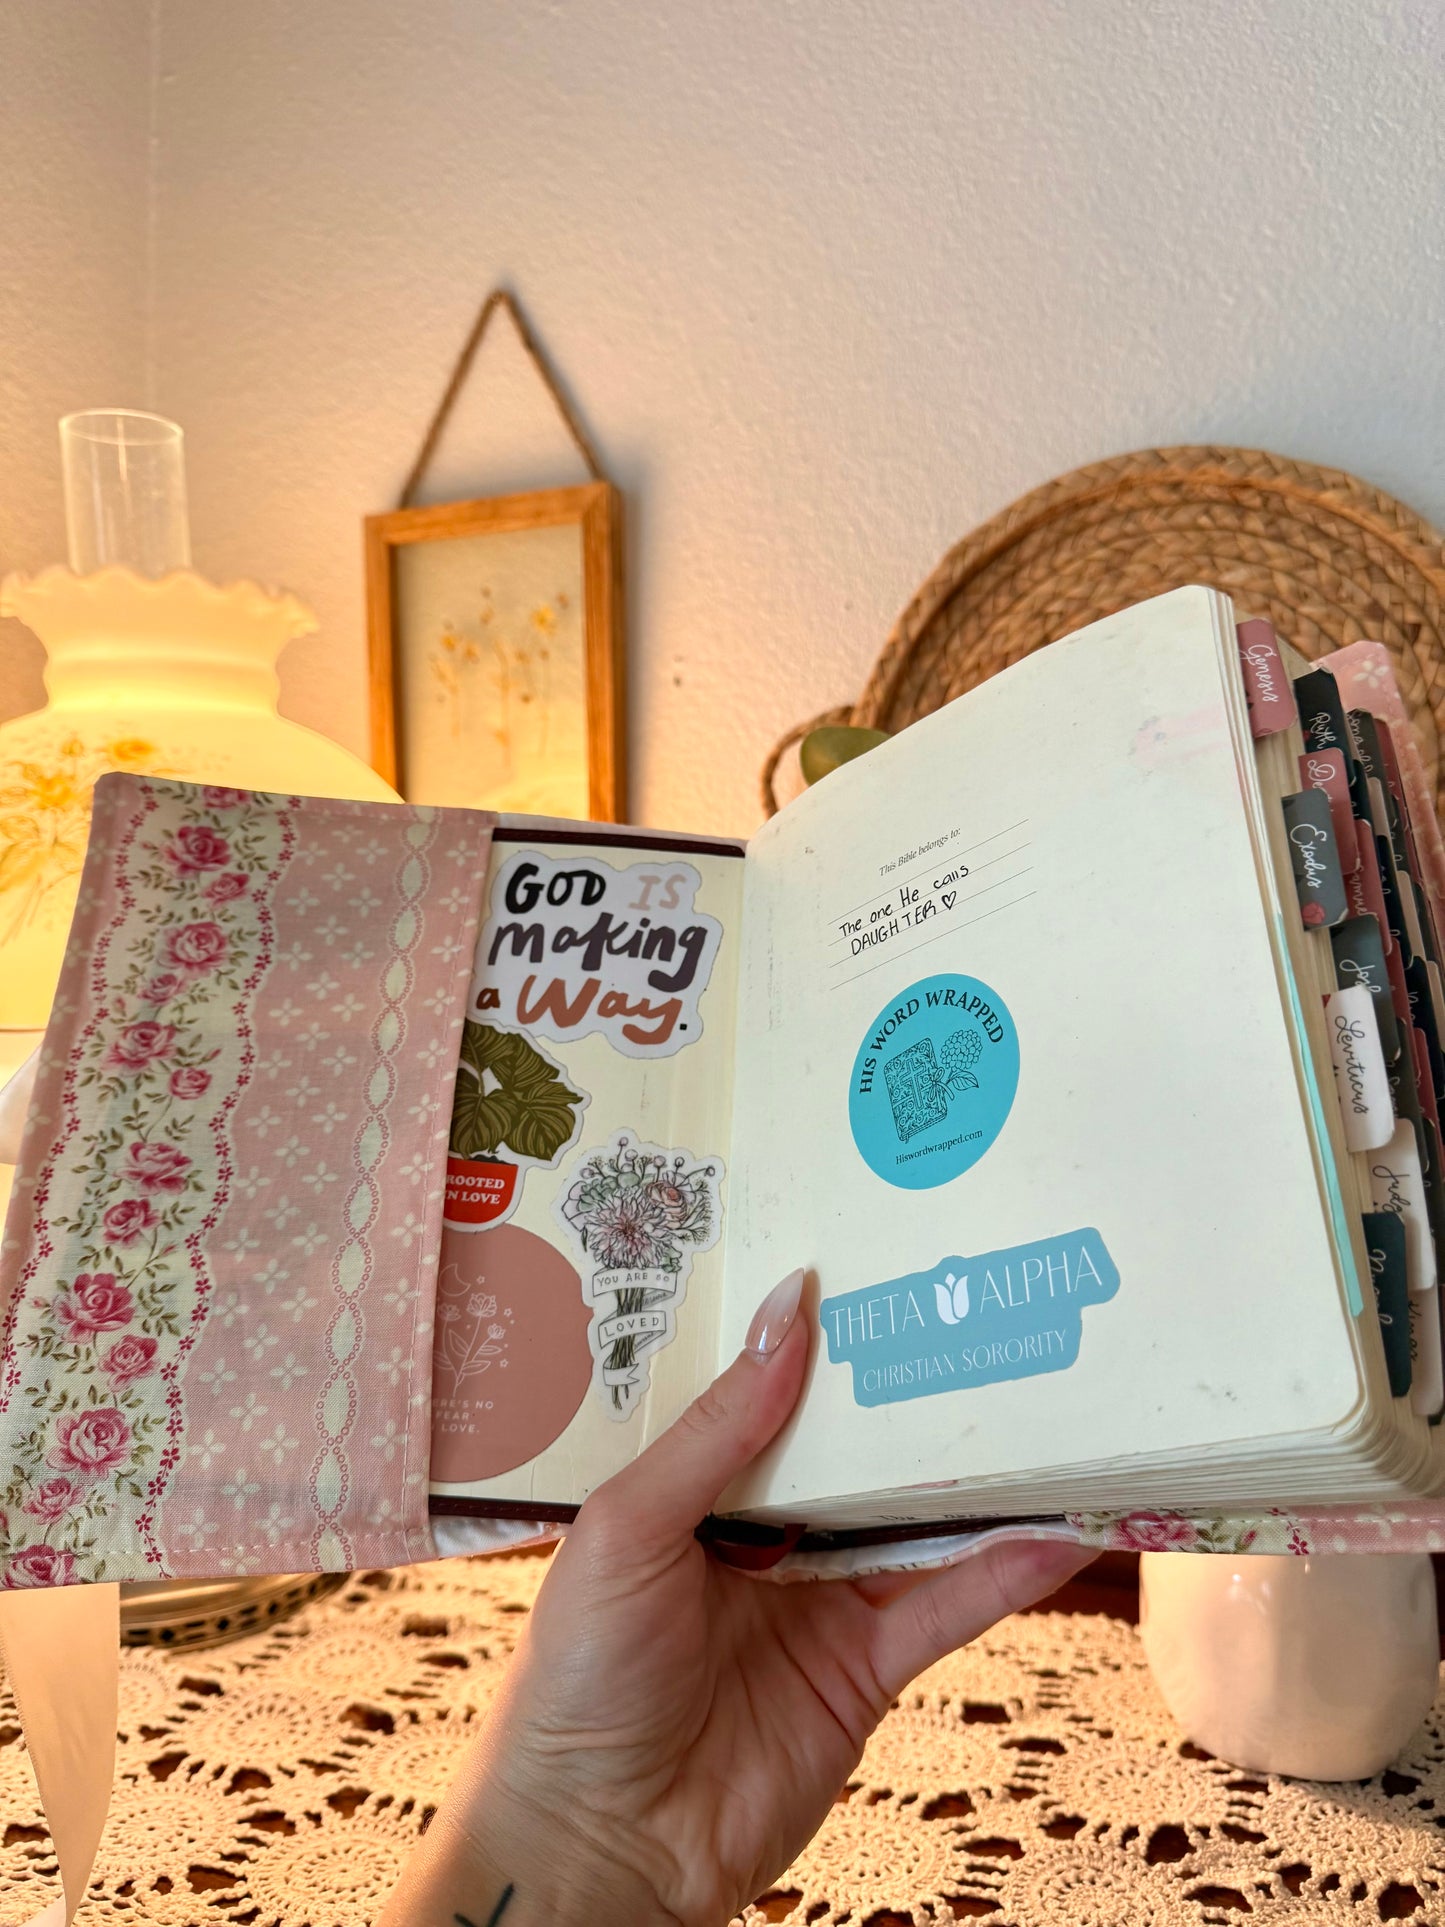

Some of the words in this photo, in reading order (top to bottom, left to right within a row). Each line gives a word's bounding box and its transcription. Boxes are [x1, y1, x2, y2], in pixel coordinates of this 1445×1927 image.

[1240, 644, 1279, 702] Genesis
[878, 861, 896, 877] This
[897, 848, 917, 868] Bible
[918, 833, 949, 857] belongs
[950, 827, 961, 840] to:
[1290, 823, 1327, 889] Exodus
[505, 862, 606, 914] GOD
[628, 873, 687, 910] IS
[838, 917, 862, 937] The
[869, 904, 893, 924] one
[899, 886, 919, 908] He
[933, 865, 969, 890] calls
[487, 912, 708, 992] making
[475, 987, 500, 1010] a
[859, 1057, 877, 1094] HIS
[870, 998, 920, 1053] WORD
[925, 988, 1004, 1043] WRAPPED
[1334, 1015, 1369, 1114] Leviticus
[895, 1129, 983, 1165] Hiswordwrapped.com
[446, 1174, 505, 1190] ROOTED
[461, 1191, 501, 1205] LOVE
[597, 1275, 619, 1287] YOU
[626, 1272, 648, 1282] ARE
[829, 1289, 925, 1348] THETA
[979, 1245, 1103, 1314] ALPHA
[604, 1316, 660, 1337] LOVED
[863, 1353, 955, 1392] CHRISTIAN
[962, 1329, 1067, 1372] SORORITY
[436, 1410, 470, 1420] FEAR
[441, 1423, 480, 1433] LOVE.
[475, 1400, 494, 1409] NO
